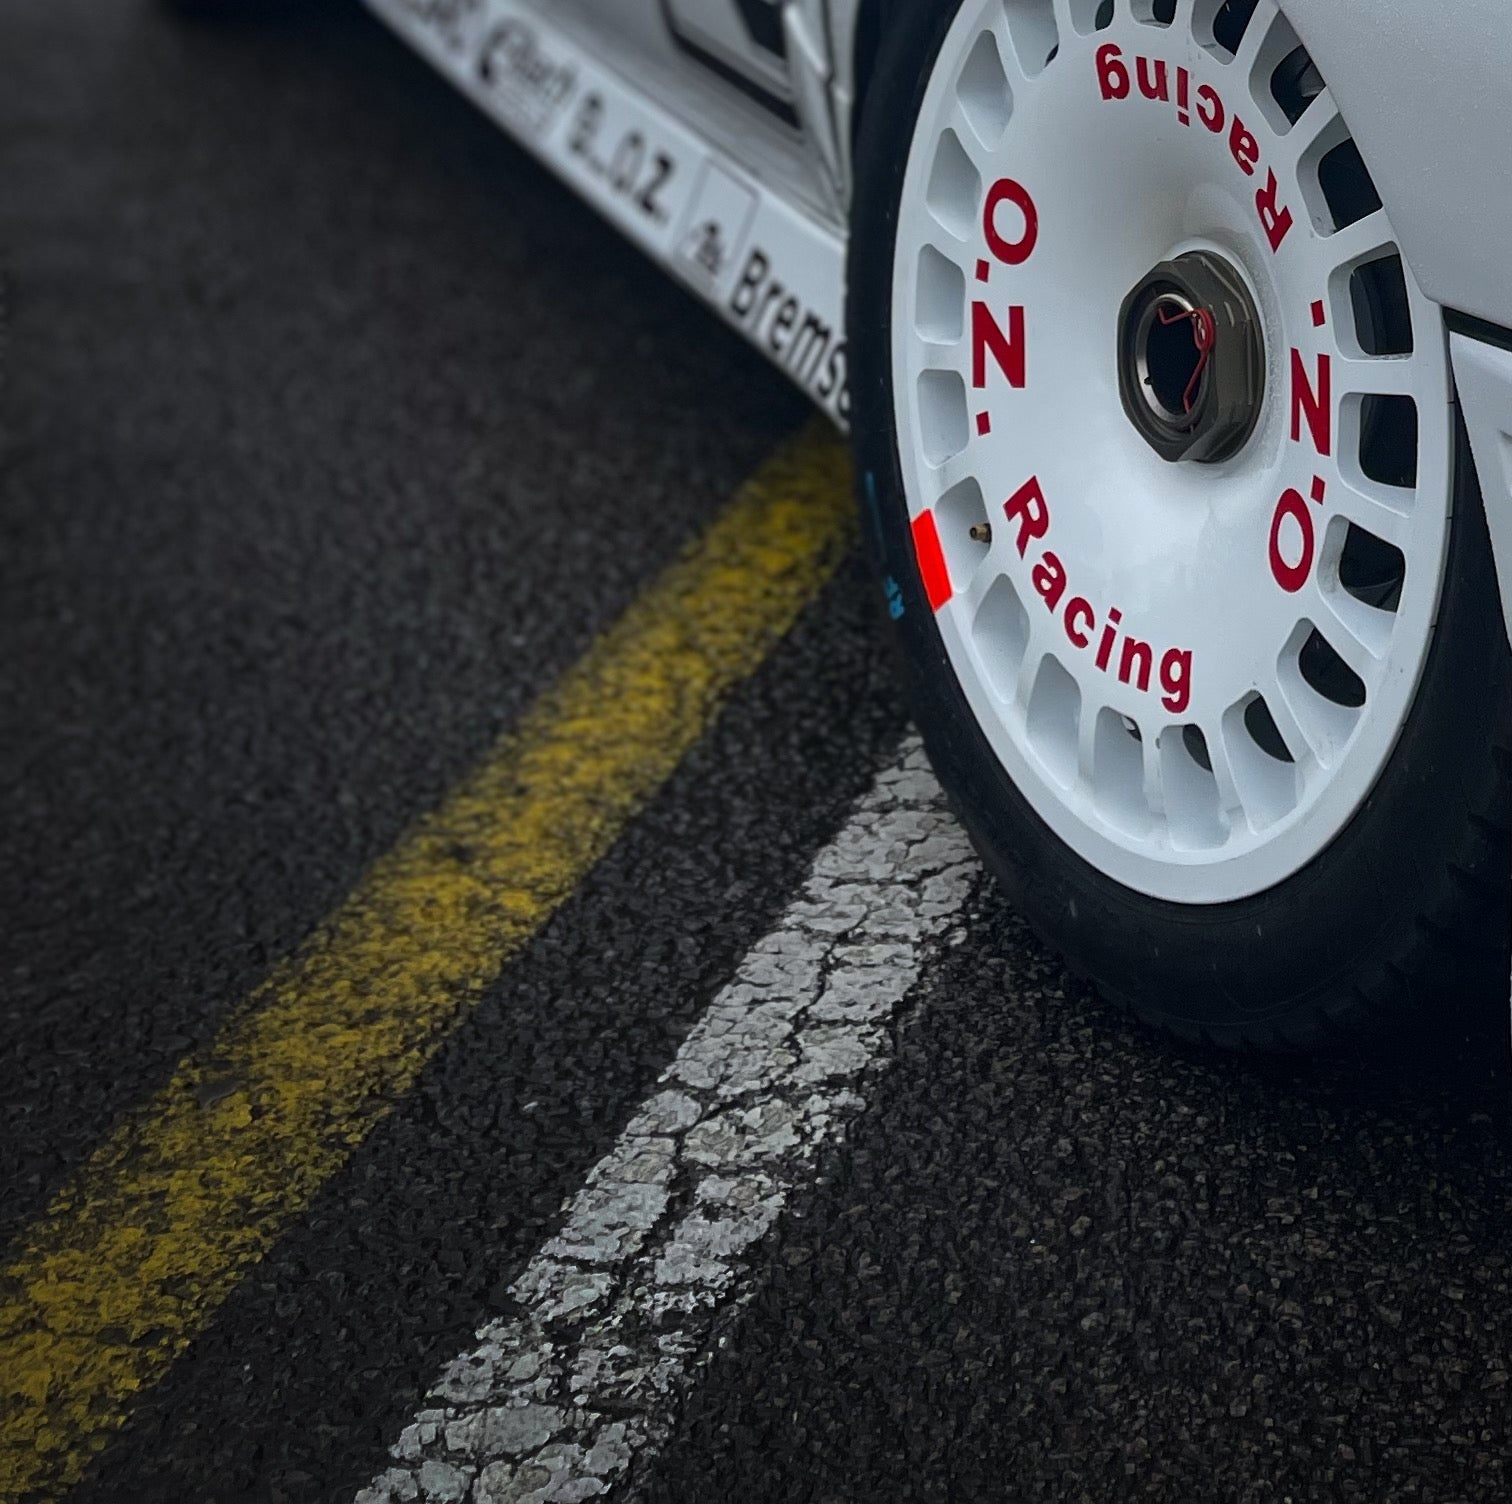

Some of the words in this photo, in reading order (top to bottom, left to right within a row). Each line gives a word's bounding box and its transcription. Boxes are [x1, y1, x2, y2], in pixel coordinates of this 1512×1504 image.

[1095, 42, 1295, 255] Racing
[971, 177, 1039, 437] O.Z.
[1268, 299, 1333, 594] O.Z.
[1002, 475, 1194, 715] Racing
